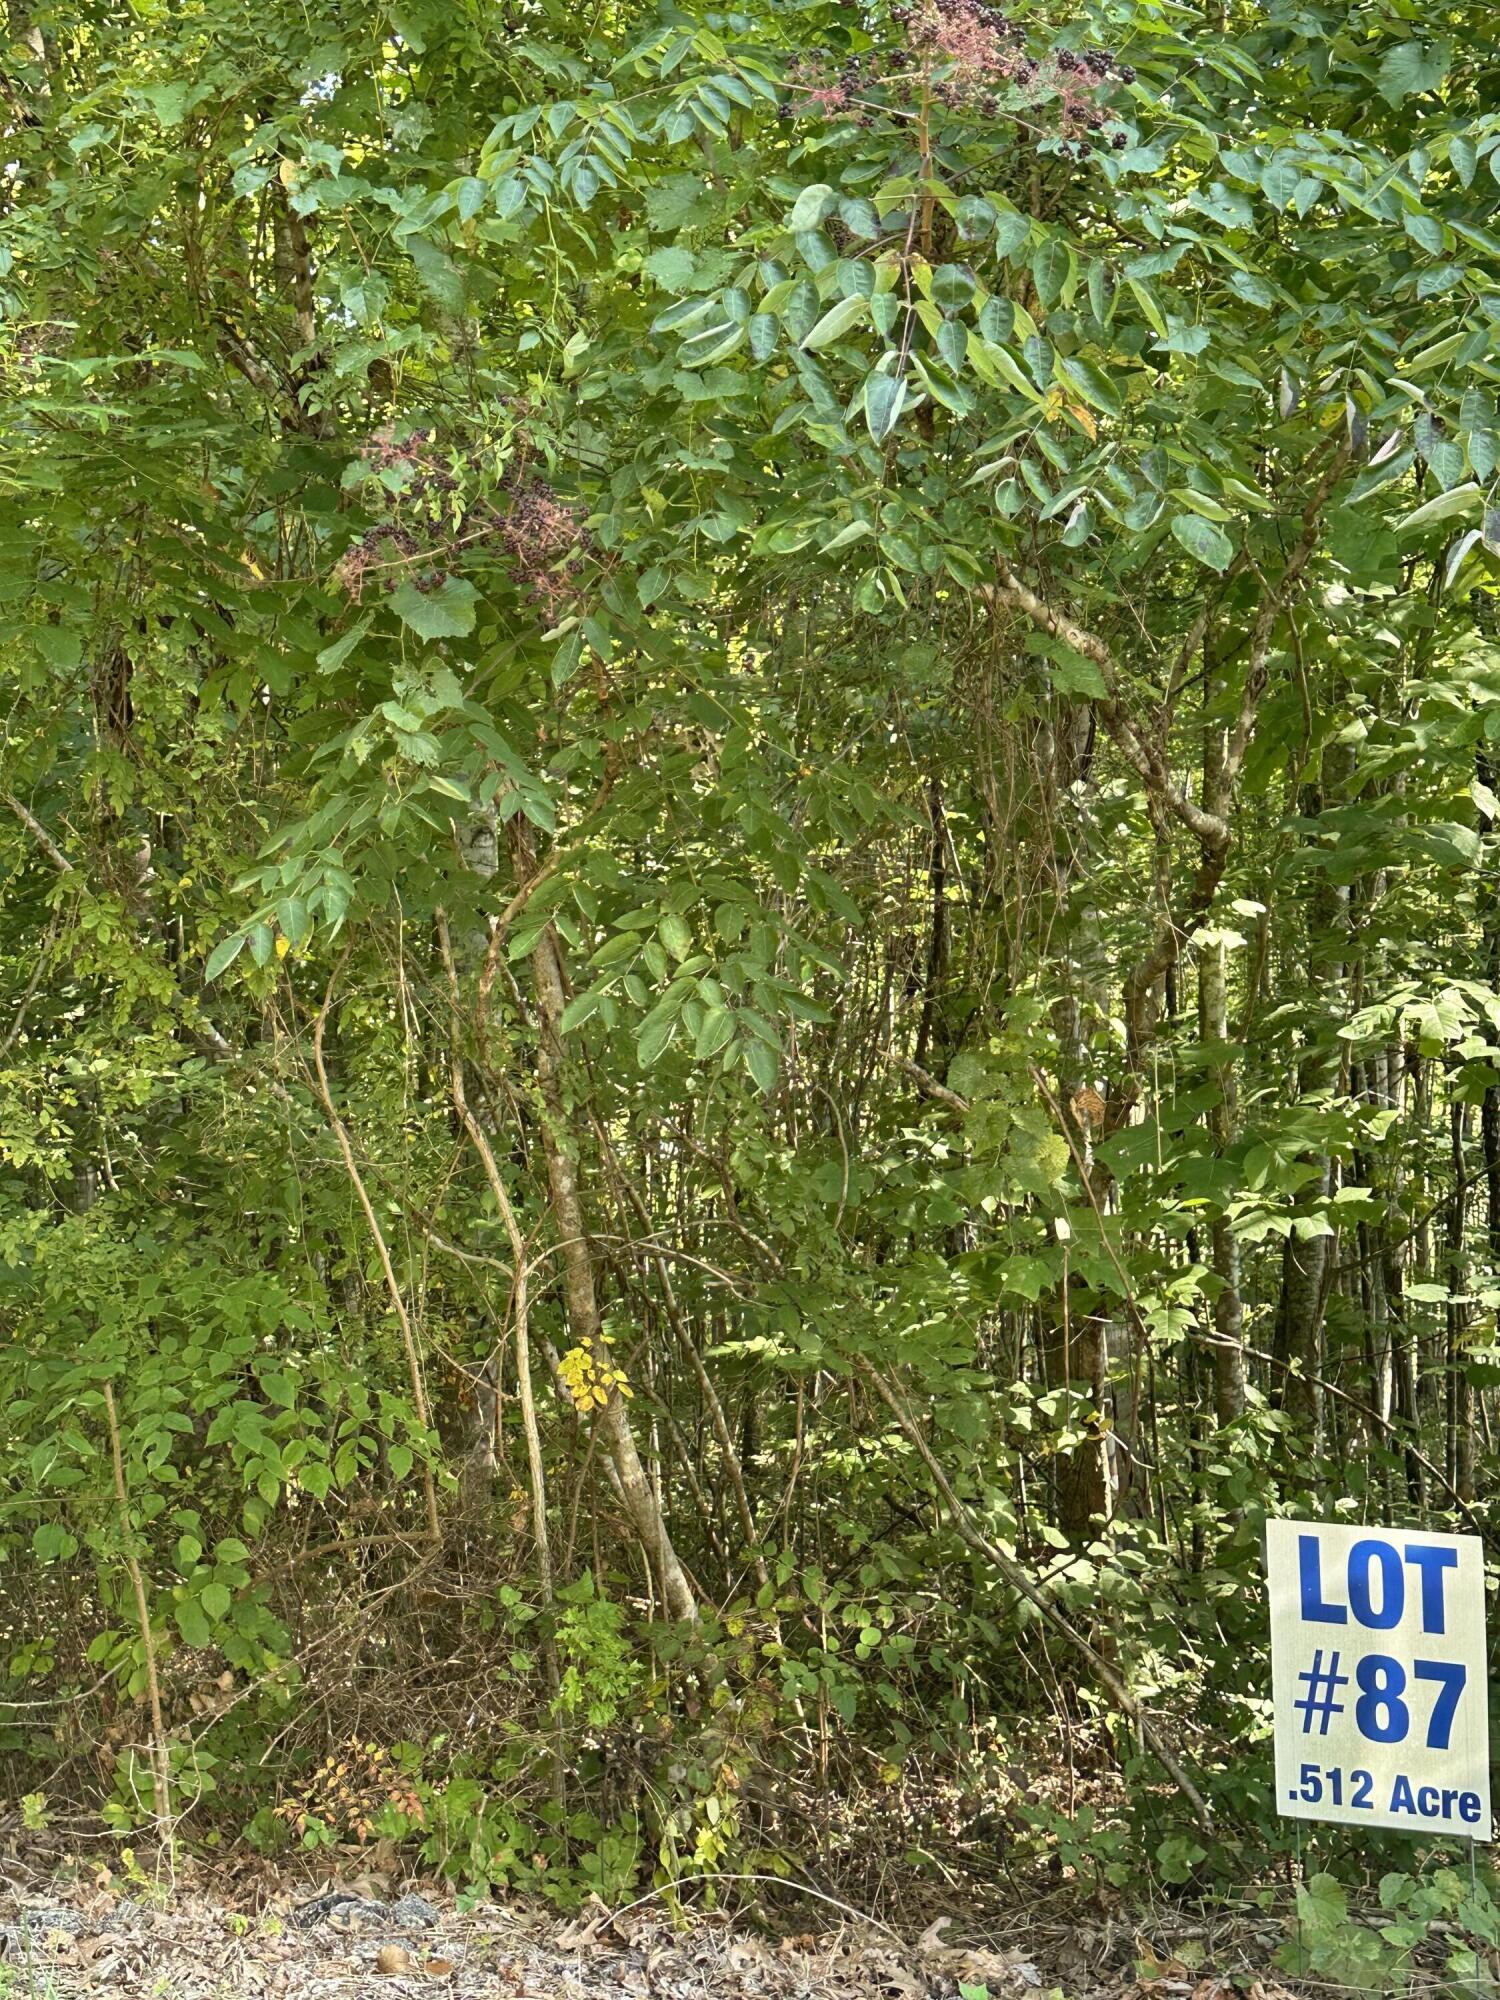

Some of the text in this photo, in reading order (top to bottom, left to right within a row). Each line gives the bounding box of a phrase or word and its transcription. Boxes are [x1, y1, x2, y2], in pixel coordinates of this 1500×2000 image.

[1298, 1535, 1458, 1635] LOT
[1294, 1649, 1467, 1750] #87
[1289, 1764, 1482, 1823] .512 Acre
